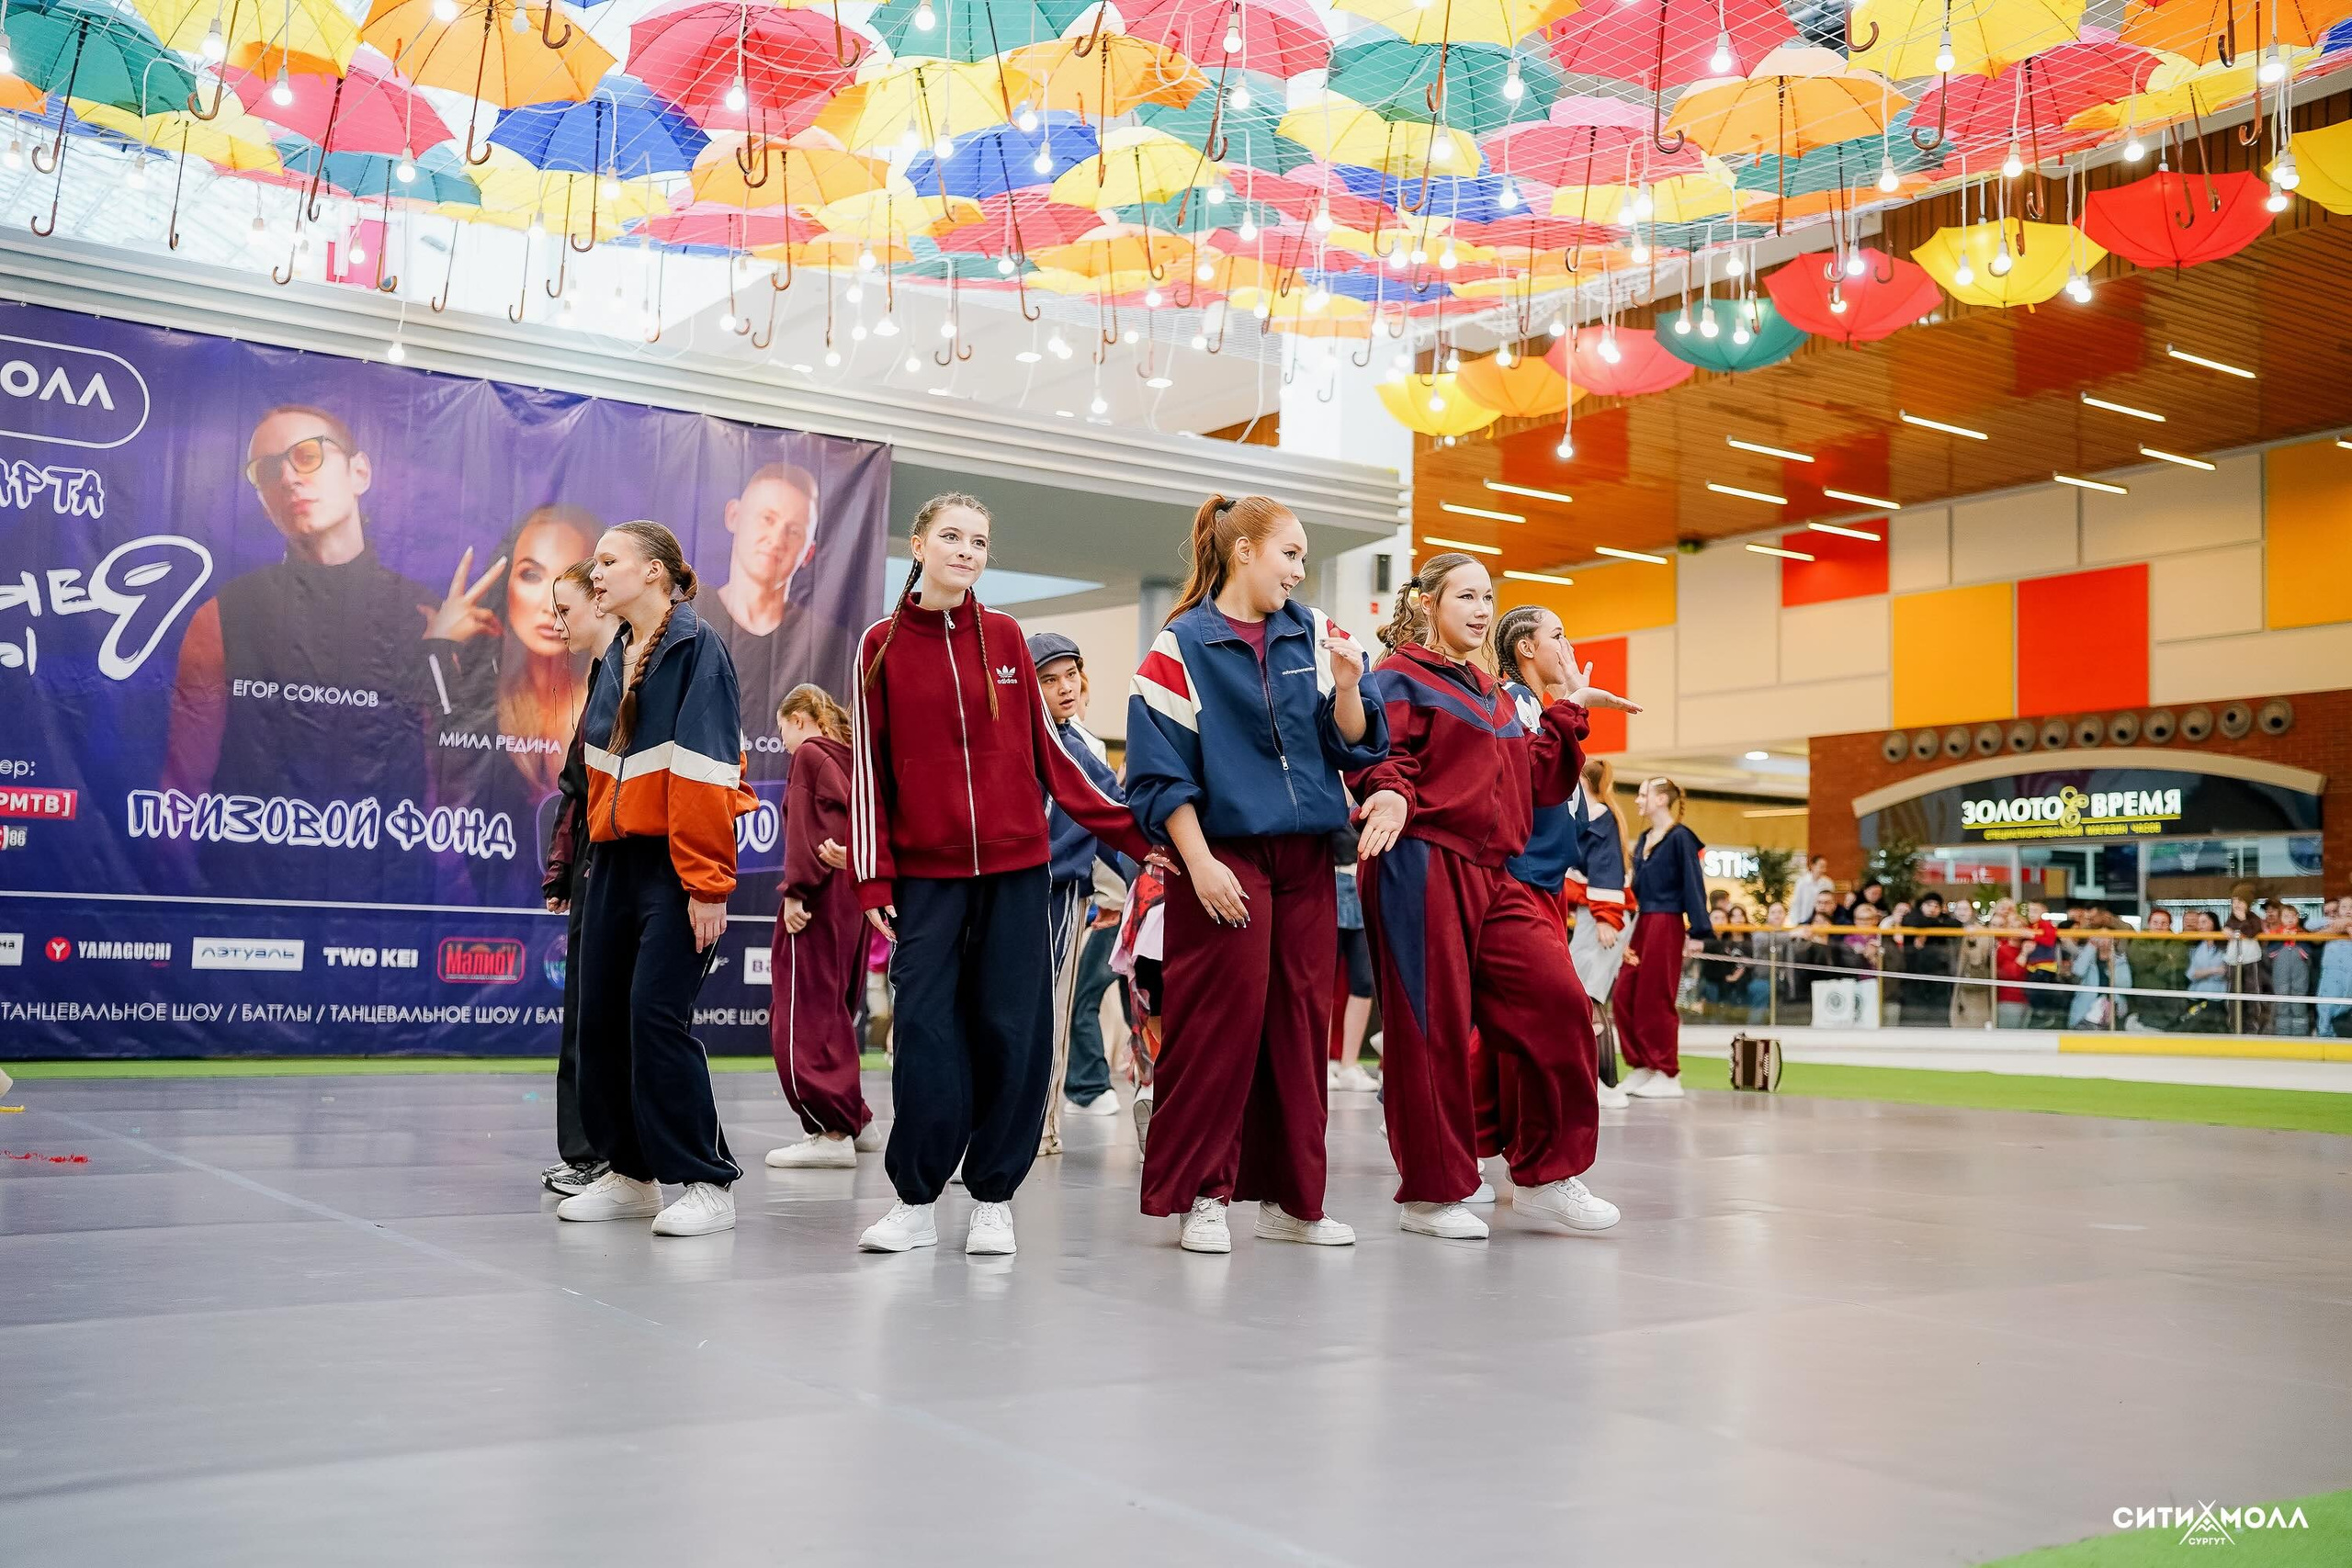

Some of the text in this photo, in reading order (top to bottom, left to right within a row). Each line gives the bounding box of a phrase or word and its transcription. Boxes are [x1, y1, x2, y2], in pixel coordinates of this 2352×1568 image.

[232, 679, 379, 707] ЕГОР СОКОЛОВ
[438, 731, 563, 755] МИЛА РЕДИНА
[1961, 788, 2182, 825] ЗОЛОТО ВРЕМЯ
[127, 788, 516, 860] ПРИЗОВОЙ ФОНД
[78, 941, 172, 961] YAMAGUCHI
[322, 946, 419, 968] TWO KEI
[0, 1001, 167, 1022] ТАНЦЕВАЛЬНОЕ
[172, 1002, 222, 1022] ШОУ
[242, 1003, 311, 1022] БАТТЛЫ
[330, 1004, 471, 1024] ТАНЦЕВАЛЬНОЕ
[475, 1005, 520, 1024] ШОУ
